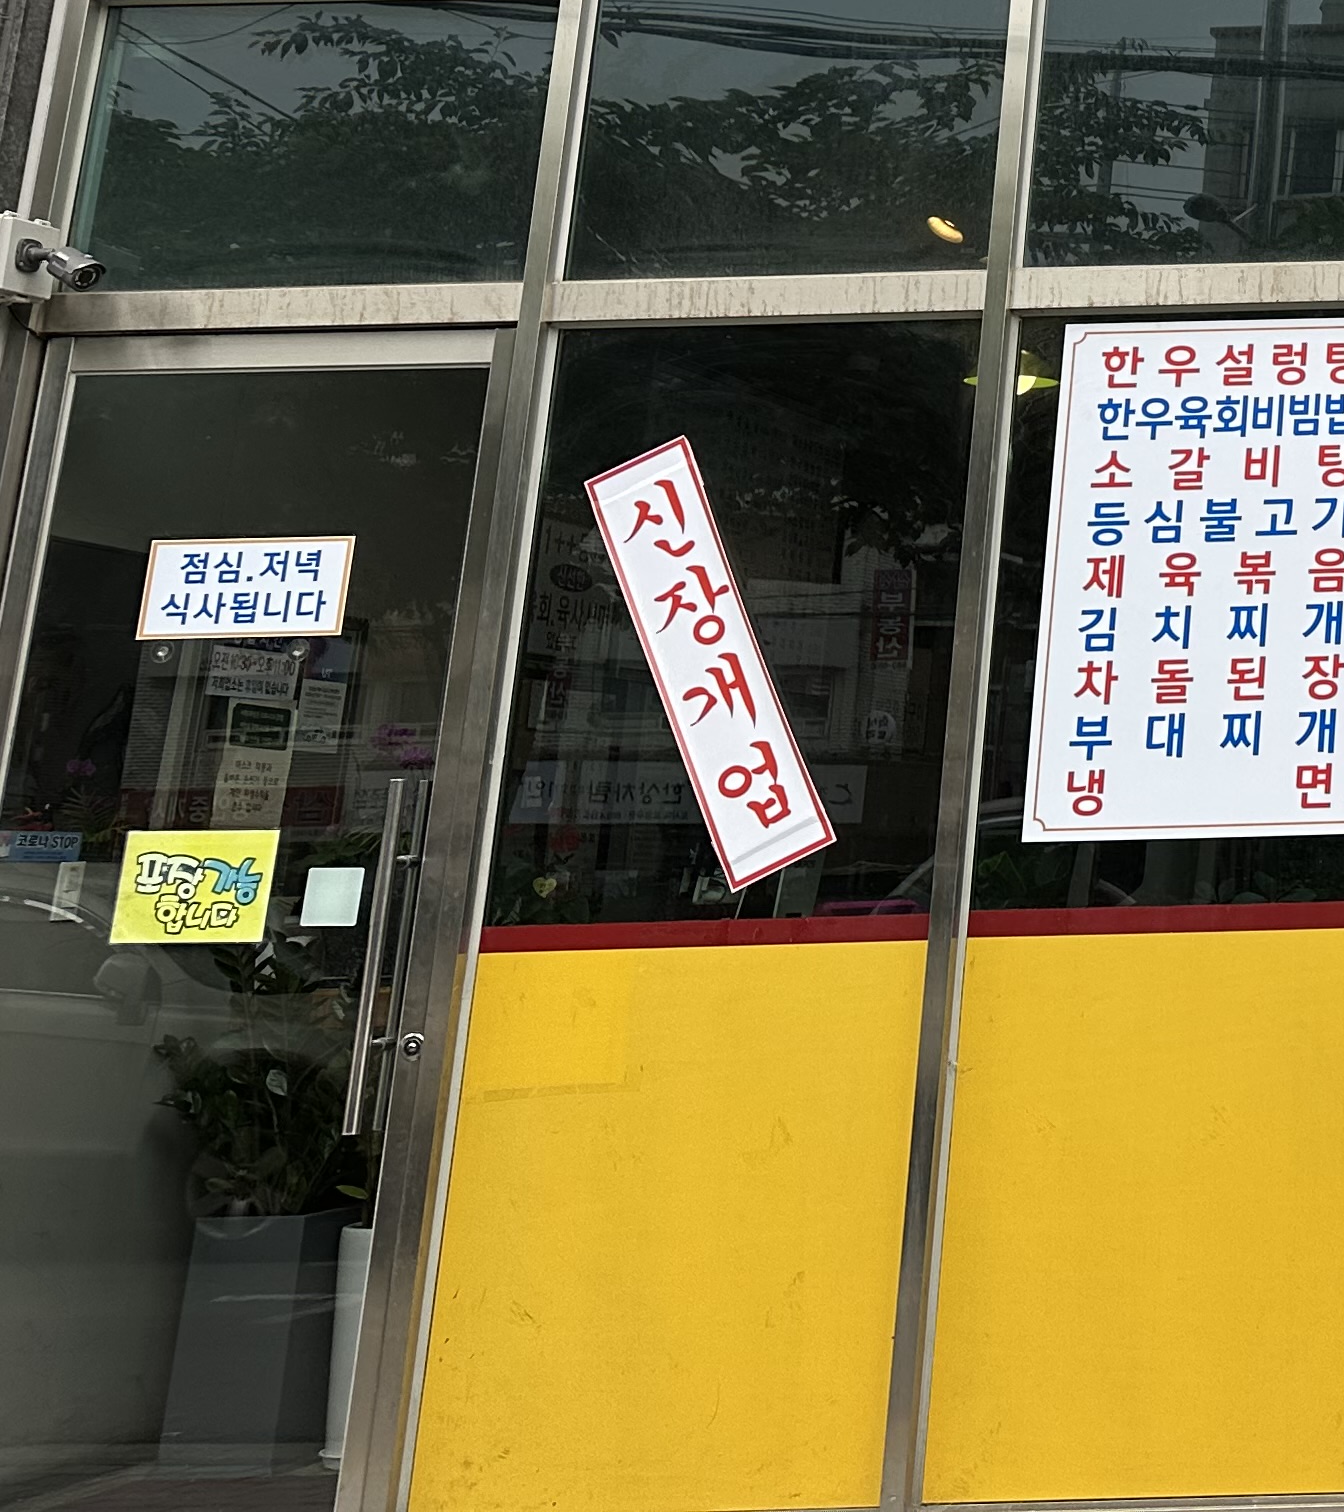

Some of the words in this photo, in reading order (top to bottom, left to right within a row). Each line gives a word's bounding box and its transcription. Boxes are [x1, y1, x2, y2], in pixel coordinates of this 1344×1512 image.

[179, 548, 323, 586] 점심.저녁
[160, 591, 328, 626] 식사됩니다
[1081, 601, 1343, 651] 김치찌개
[622, 478, 793, 830] 신장개업
[1078, 656, 1343, 703] 차돌된장
[1071, 709, 1336, 760] 부대찌개
[16, 834, 49, 848] 코로나
[51, 835, 79, 848] STOP
[154, 892, 240, 935] 합니다
